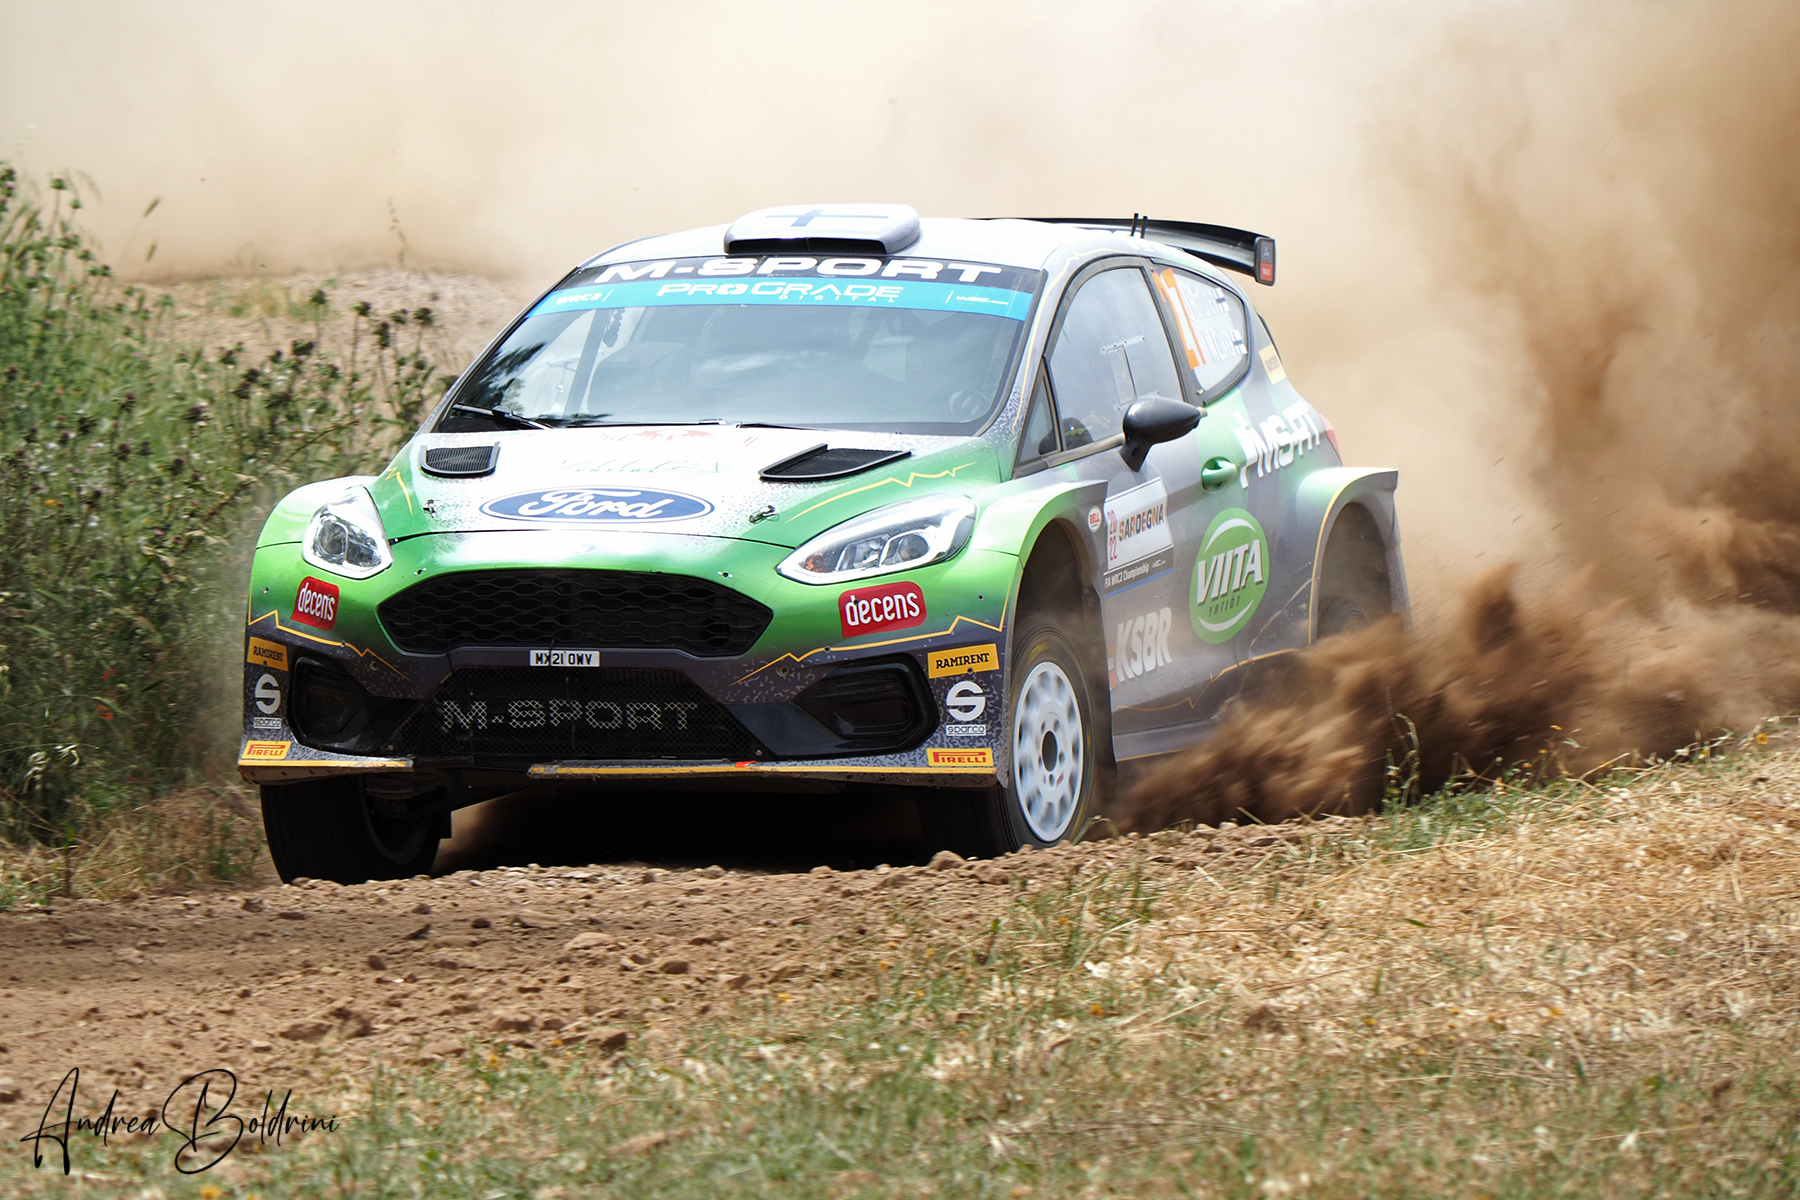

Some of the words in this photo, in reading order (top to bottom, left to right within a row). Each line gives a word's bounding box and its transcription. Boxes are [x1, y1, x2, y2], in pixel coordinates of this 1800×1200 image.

[594, 257, 1003, 284] M-SPORT
[778, 294, 895, 303] DIGITAL
[517, 489, 675, 518] Ford
[1089, 511, 1101, 525] BELL
[1118, 503, 1165, 542] SARDEGNA
[1123, 562, 1150, 581] Championship
[1196, 539, 1264, 606] VIITA
[297, 582, 335, 621] decens
[845, 592, 920, 626] decens
[252, 645, 284, 662] RAMIRENT
[1116, 606, 1173, 683] KSBR
[535, 652, 564, 665] MX21
[568, 652, 592, 665] OWV
[935, 652, 990, 670] RAMIRENT
[254, 717, 282, 727] sparco
[946, 725, 985, 734] sparco
[247, 743, 286, 756] PIRELLI
[933, 751, 987, 764] PIRELLI
